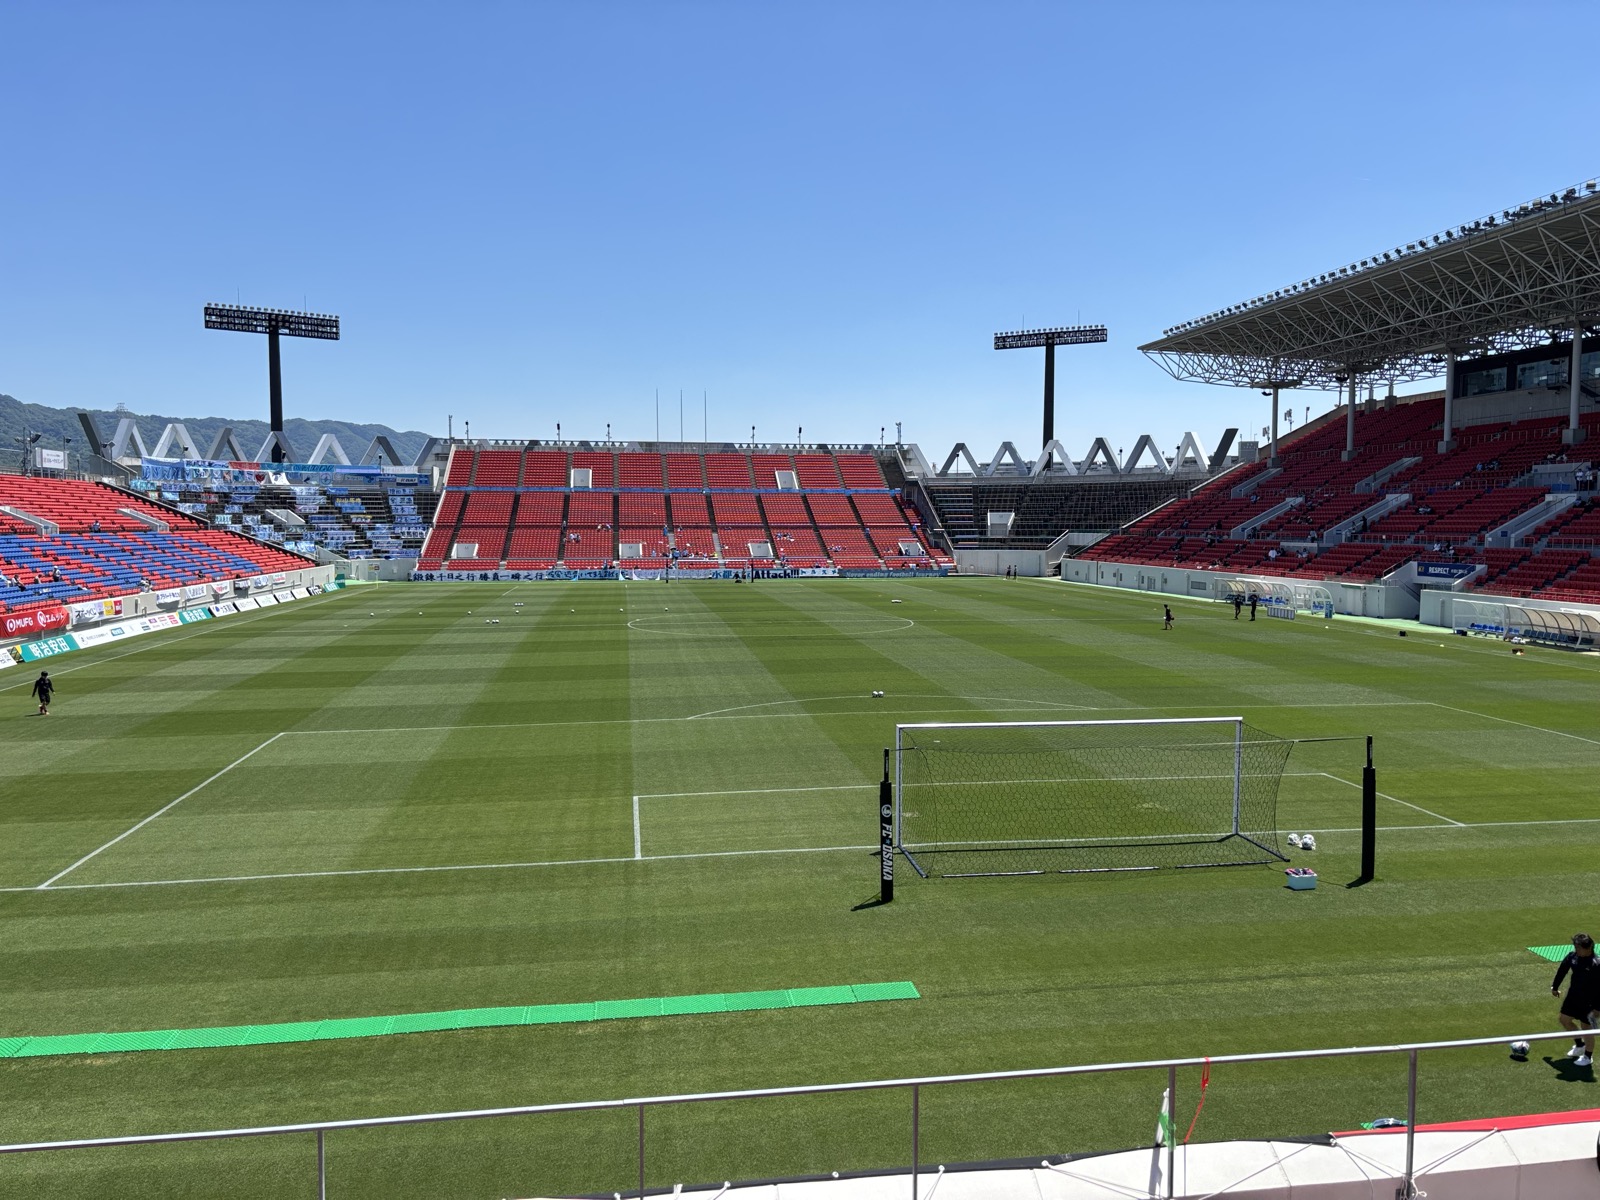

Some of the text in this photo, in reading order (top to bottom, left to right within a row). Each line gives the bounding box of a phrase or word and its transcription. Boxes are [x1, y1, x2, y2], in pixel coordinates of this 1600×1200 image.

[754, 569, 800, 579] Attack!!!
[1428, 566, 1450, 574] RESPECT
[15, 617, 34, 628] MUFG
[28, 637, 70, 658] 明治安田
[882, 823, 893, 881] FC OSAKA
